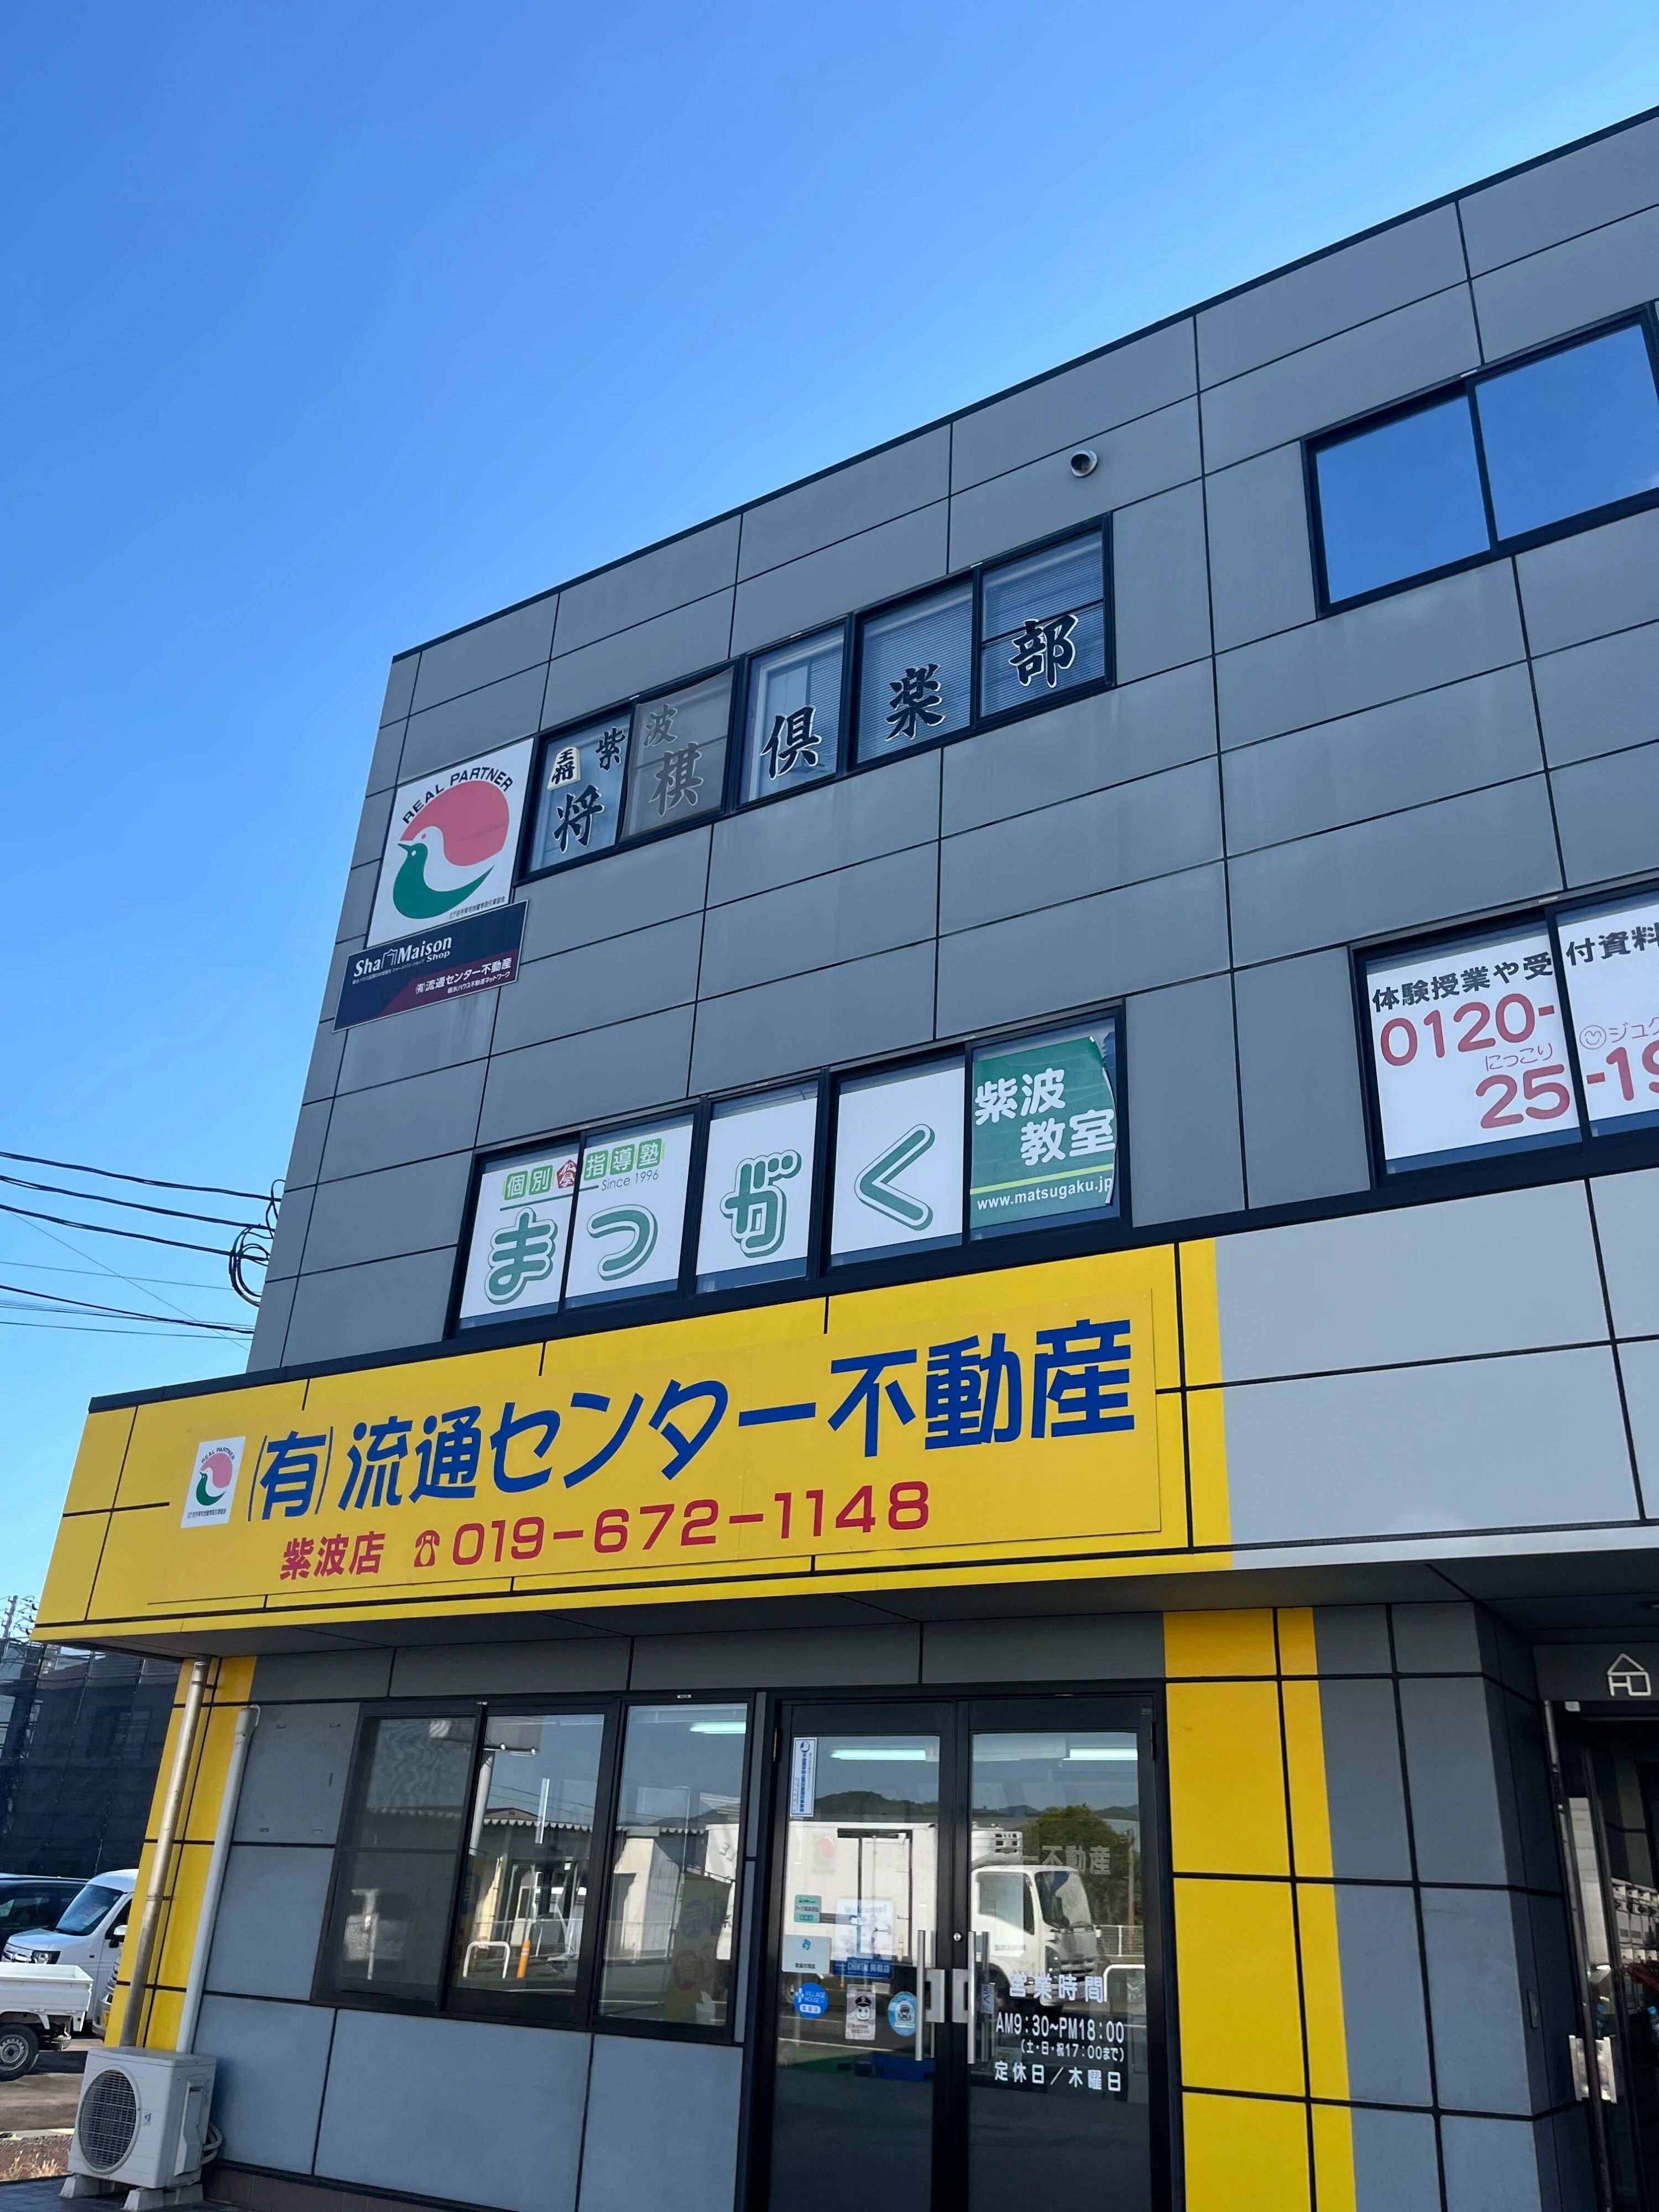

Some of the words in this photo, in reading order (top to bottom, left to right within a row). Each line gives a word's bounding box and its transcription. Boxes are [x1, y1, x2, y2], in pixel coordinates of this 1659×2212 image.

[551, 748, 575, 784] 王将
[403, 784, 444, 824] REAL
[450, 767, 513, 792] PARTNER
[426, 950, 450, 962] Shop
[1381, 994, 1555, 1066] 0120-
[1485, 1043, 1553, 1071] にっこり
[974, 1068, 1066, 1125] 紫波
[1020, 1109, 1115, 1166] 教室
[507, 1167, 551, 1198] 個別
[586, 1142, 659, 1178] 指導塾
[602, 1177, 630, 1191] Since
[636, 1169, 659, 1184] 1996
[484, 1124, 935, 1305] まつがく
[977, 1176, 1113, 1211] www.matsugaku.jp
[201, 1450, 215, 1463] REAL
[216, 1447, 235, 1460] PARTNER
[279, 1530, 385, 1581] 紫波店
[453, 1481, 930, 1566] 019-672-1148
[1009, 1970, 1103, 2003] 営業時間
